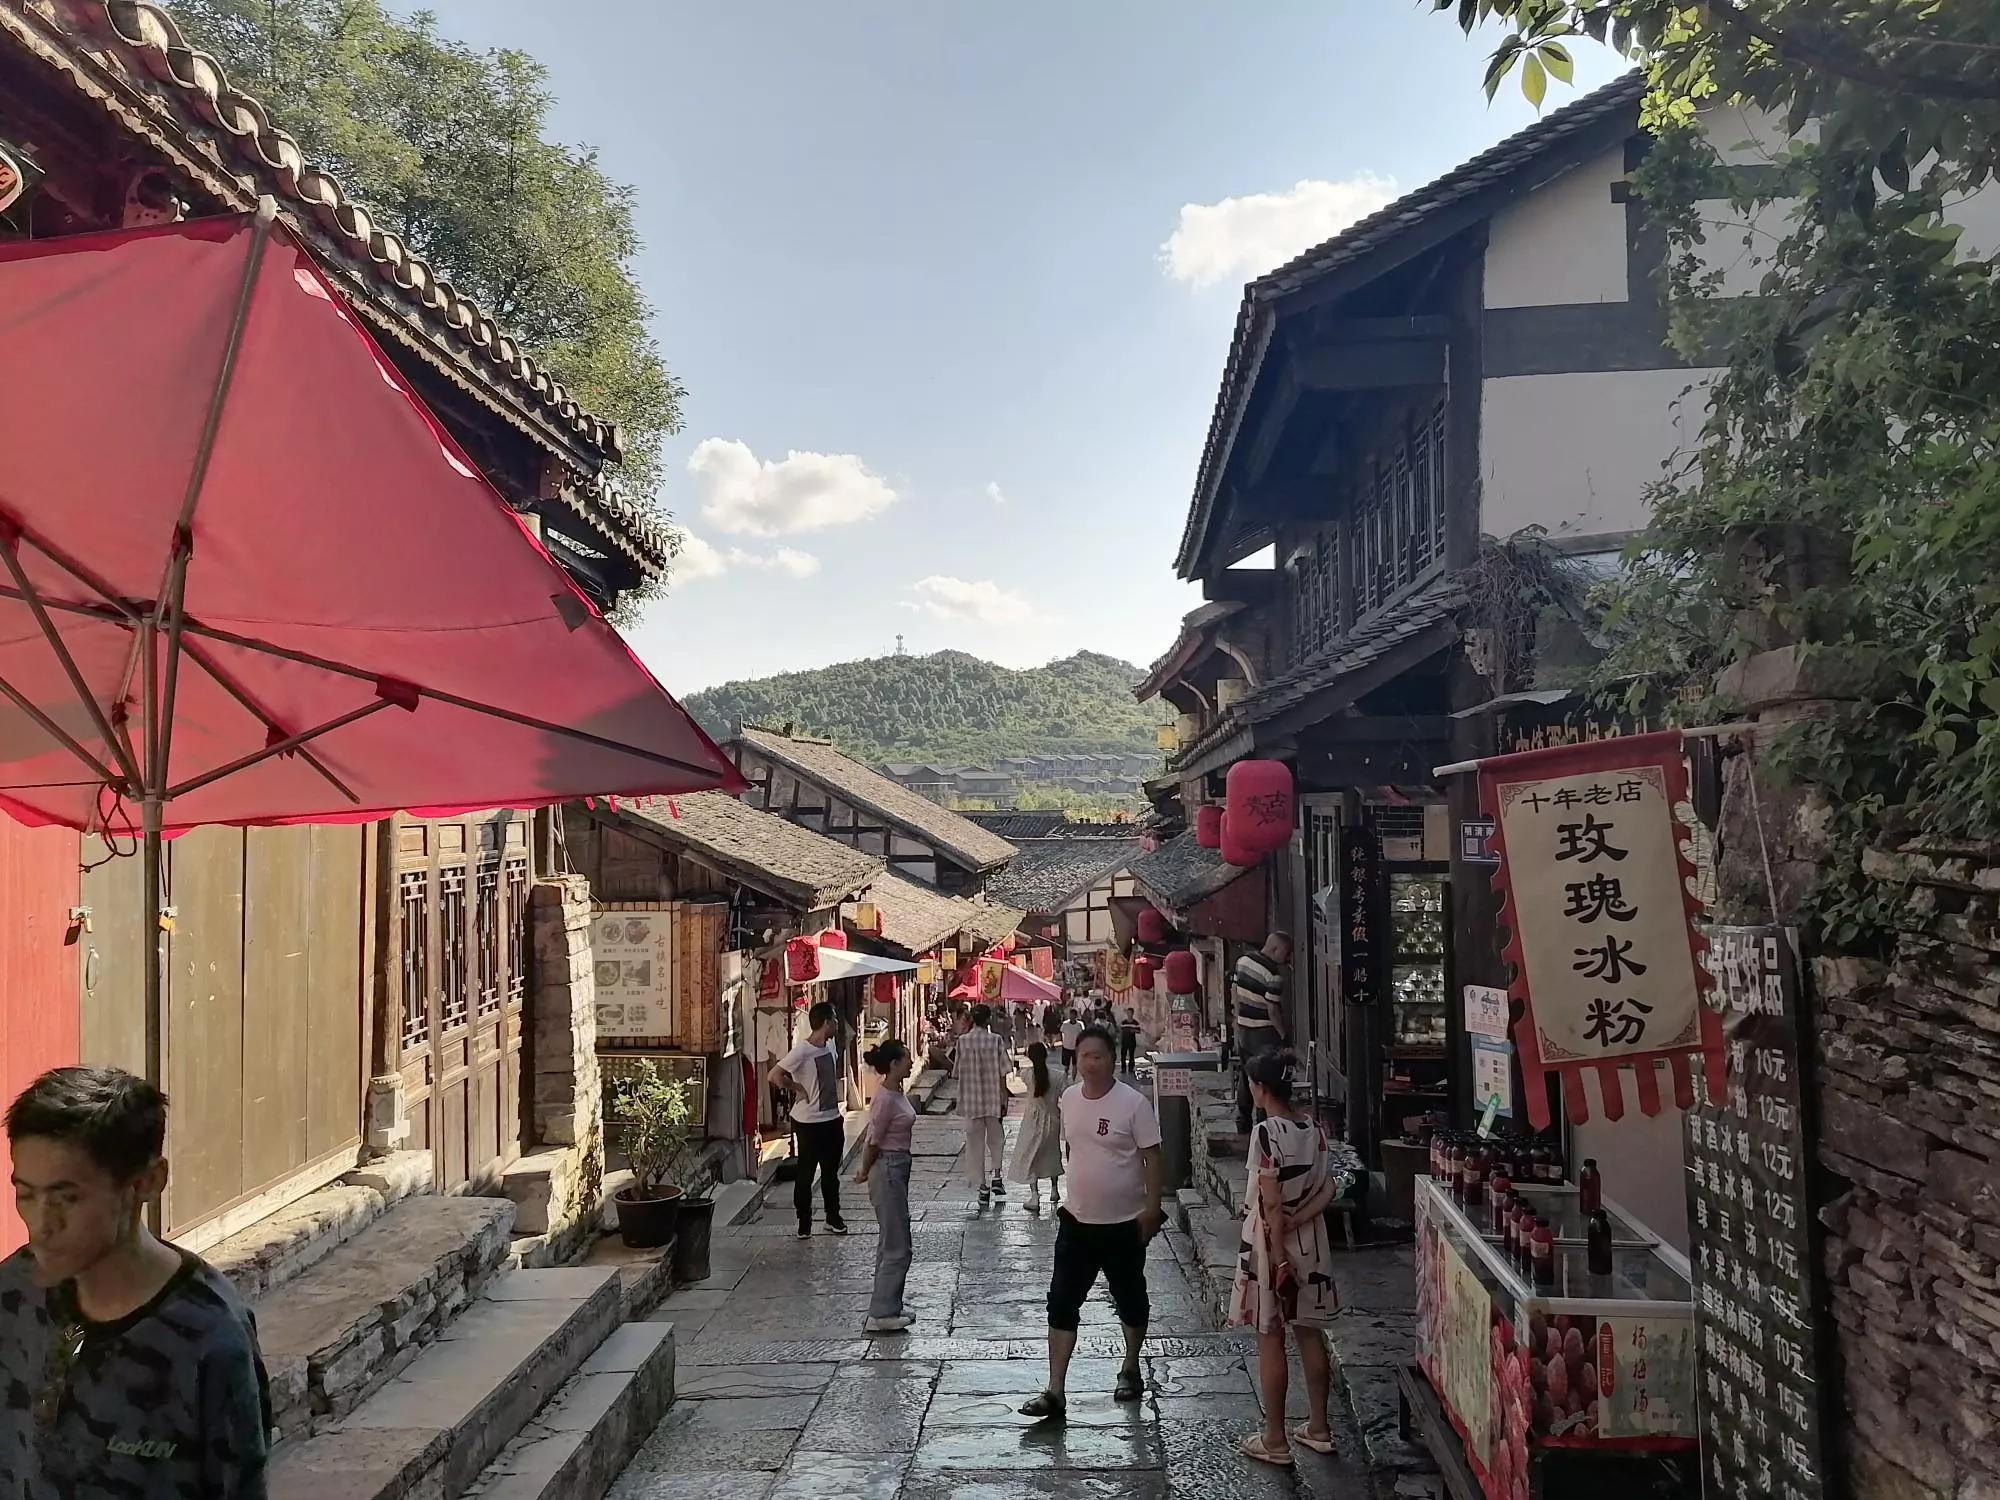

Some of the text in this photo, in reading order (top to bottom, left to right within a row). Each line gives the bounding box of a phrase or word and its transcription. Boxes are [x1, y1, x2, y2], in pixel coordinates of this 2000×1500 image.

[1521, 780, 1643, 814] 十年老店
[1555, 812, 1654, 1048] 玫瑰冰粉
[1755, 1046, 1788, 1082] 10元
[1759, 1094, 1790, 1131] 12元
[1761, 1141, 1794, 1180] 12元
[1764, 1189, 1797, 1230] 12元
[1768, 1237, 1799, 1279] 12元
[1632, 1324, 1649, 1415] 杨梅汤
[1777, 1382, 1809, 1431] 15元
